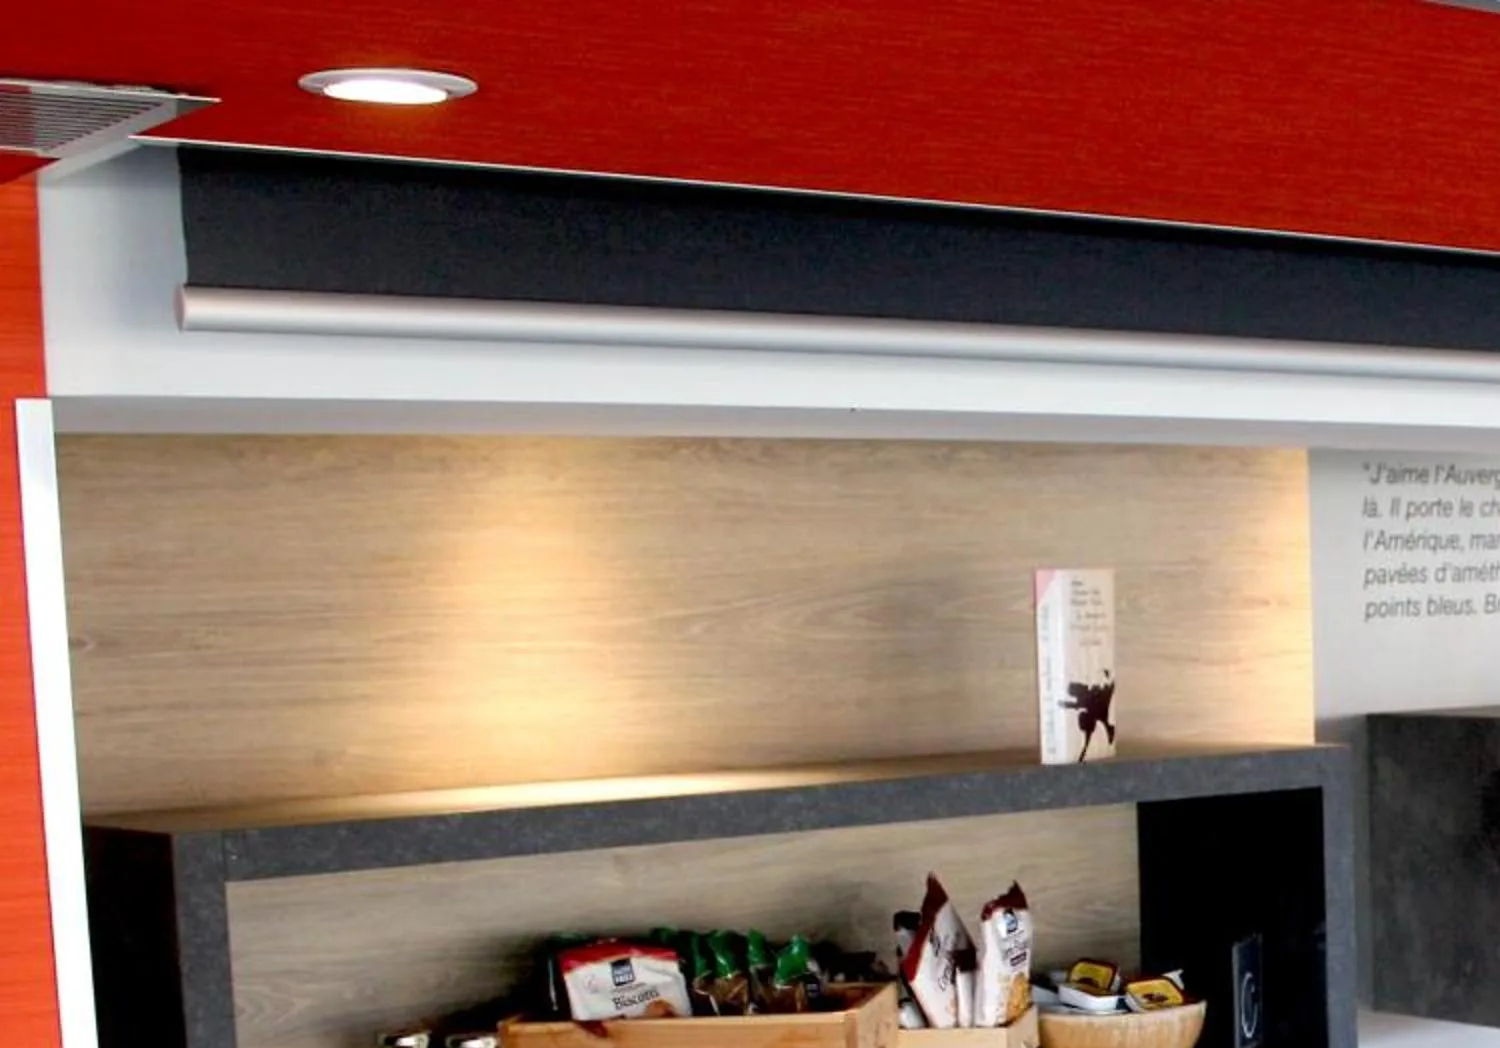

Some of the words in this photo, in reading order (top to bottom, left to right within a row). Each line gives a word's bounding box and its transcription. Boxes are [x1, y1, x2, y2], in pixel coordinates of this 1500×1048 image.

[1405, 497, 1454, 521] porte
[1458, 495, 1475, 518] le
[1362, 561, 1429, 591] pavées
[1363, 595, 1422, 624] points
[1426, 594, 1478, 618] bleus.
